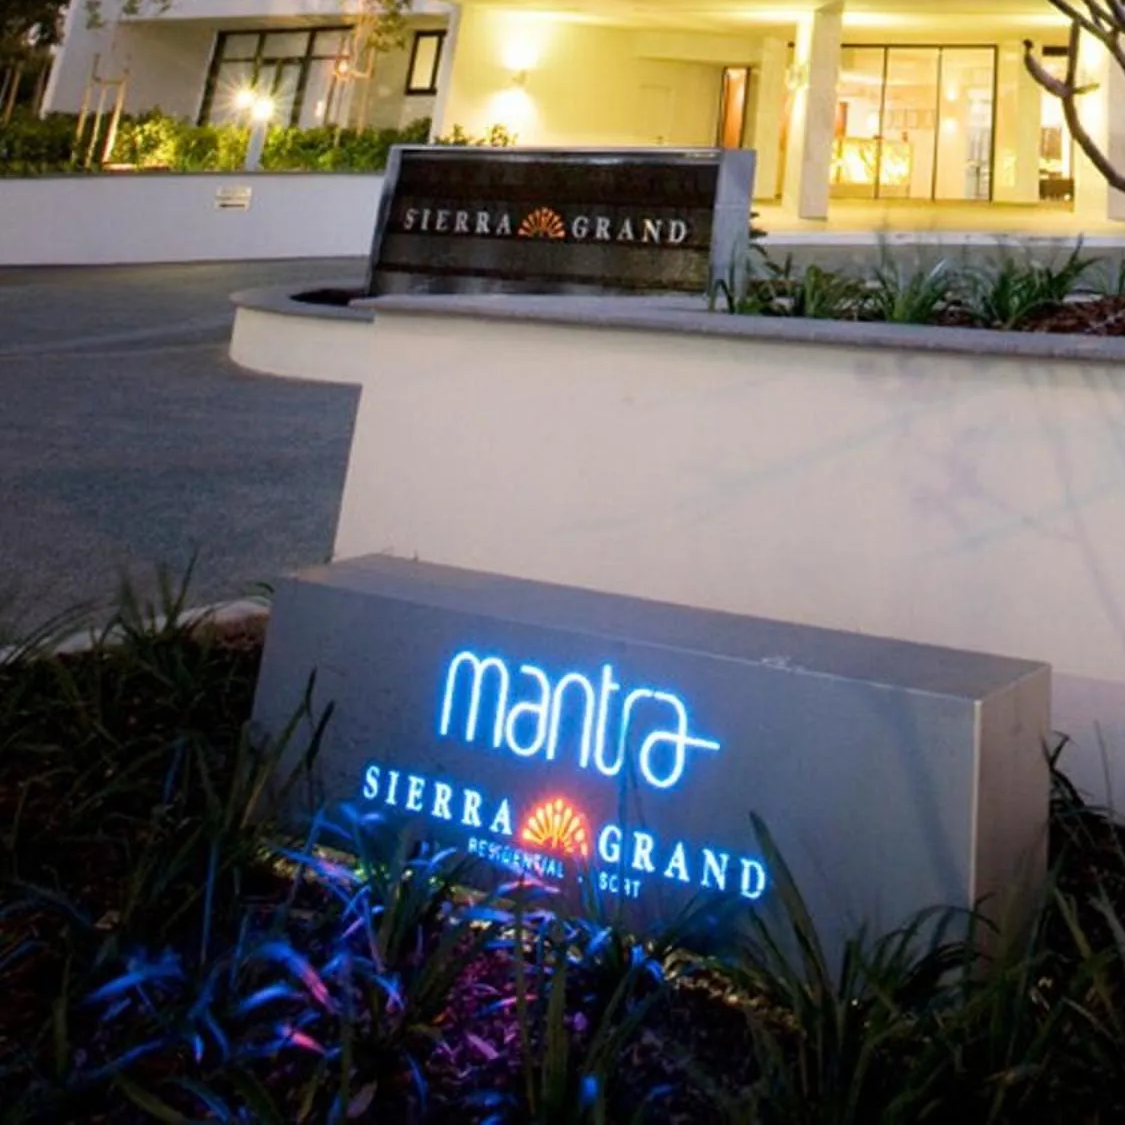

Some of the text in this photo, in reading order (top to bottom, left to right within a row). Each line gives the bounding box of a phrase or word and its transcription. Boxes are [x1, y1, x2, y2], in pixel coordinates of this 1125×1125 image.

[403, 207, 688, 245] SIERRA GRAND
[439, 651, 721, 789] mantra
[362, 764, 767, 900] SIERRA GRAND
